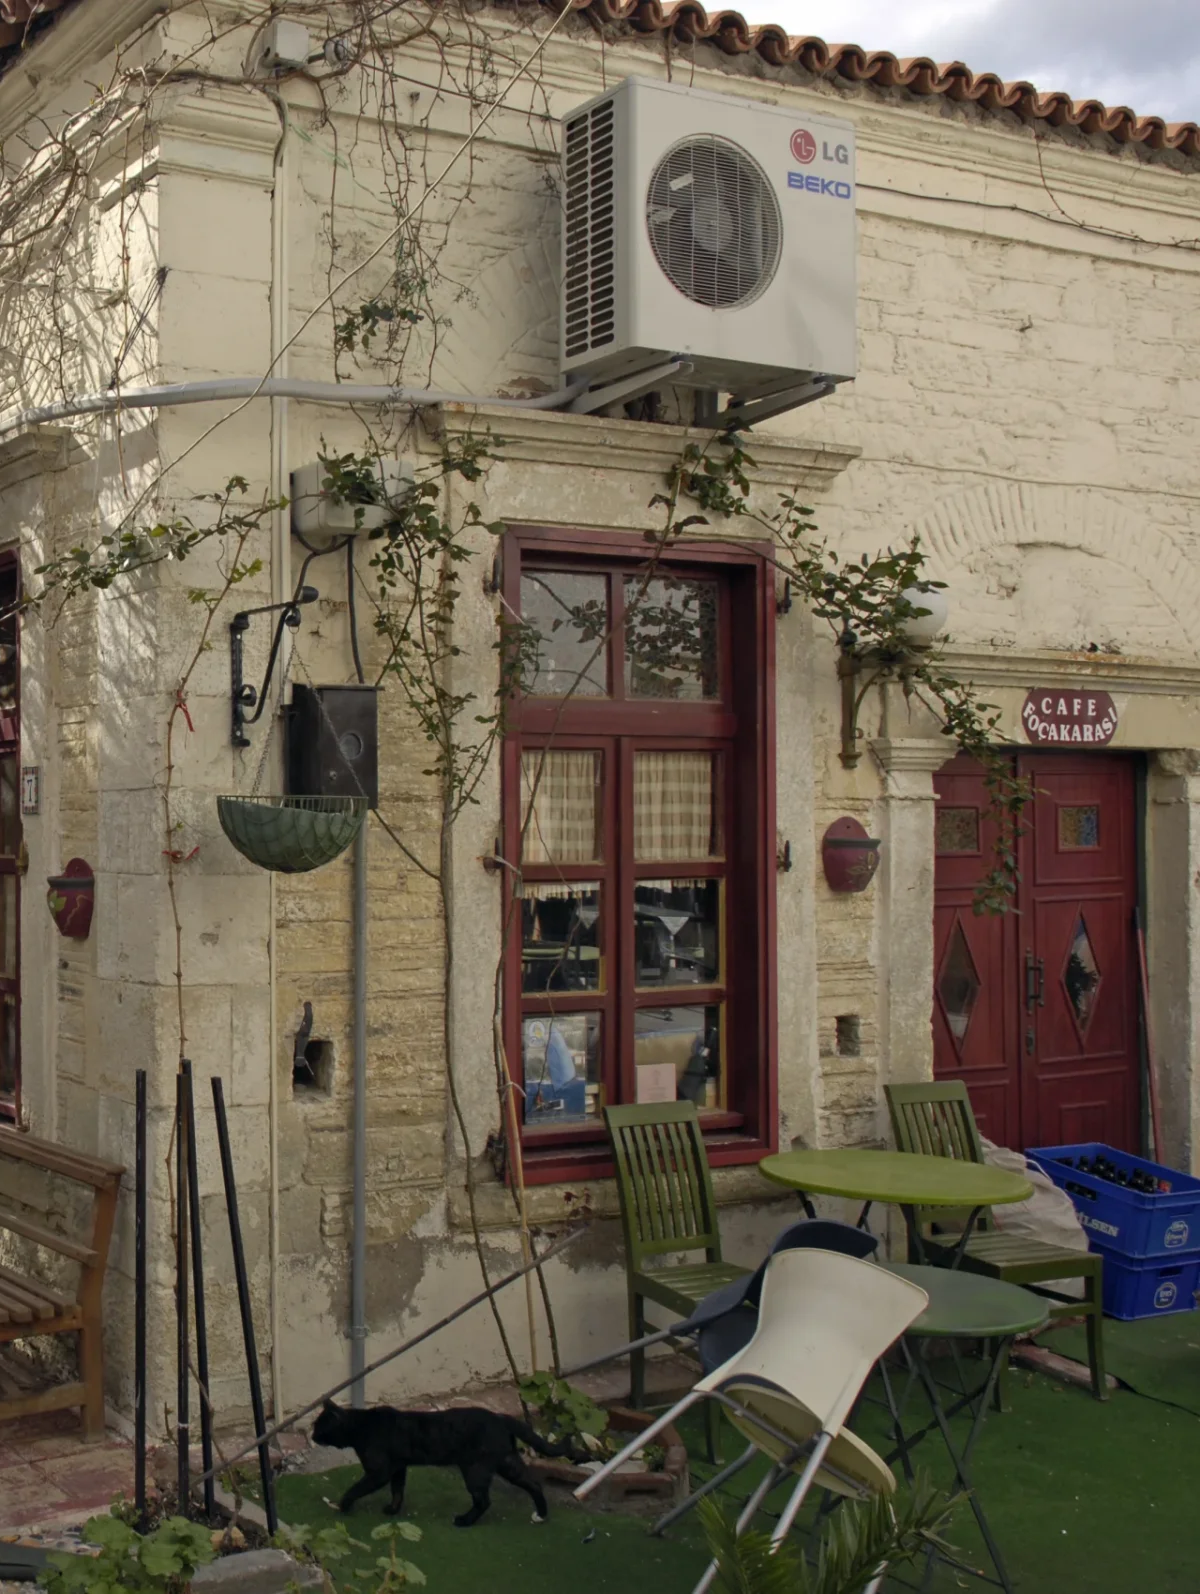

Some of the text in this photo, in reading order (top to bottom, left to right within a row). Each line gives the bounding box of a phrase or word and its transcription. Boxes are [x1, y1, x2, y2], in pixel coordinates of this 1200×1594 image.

[822, 141, 849, 165] LG
[787, 171, 851, 199] BEKO
[1041, 697, 1097, 716] CAFE
